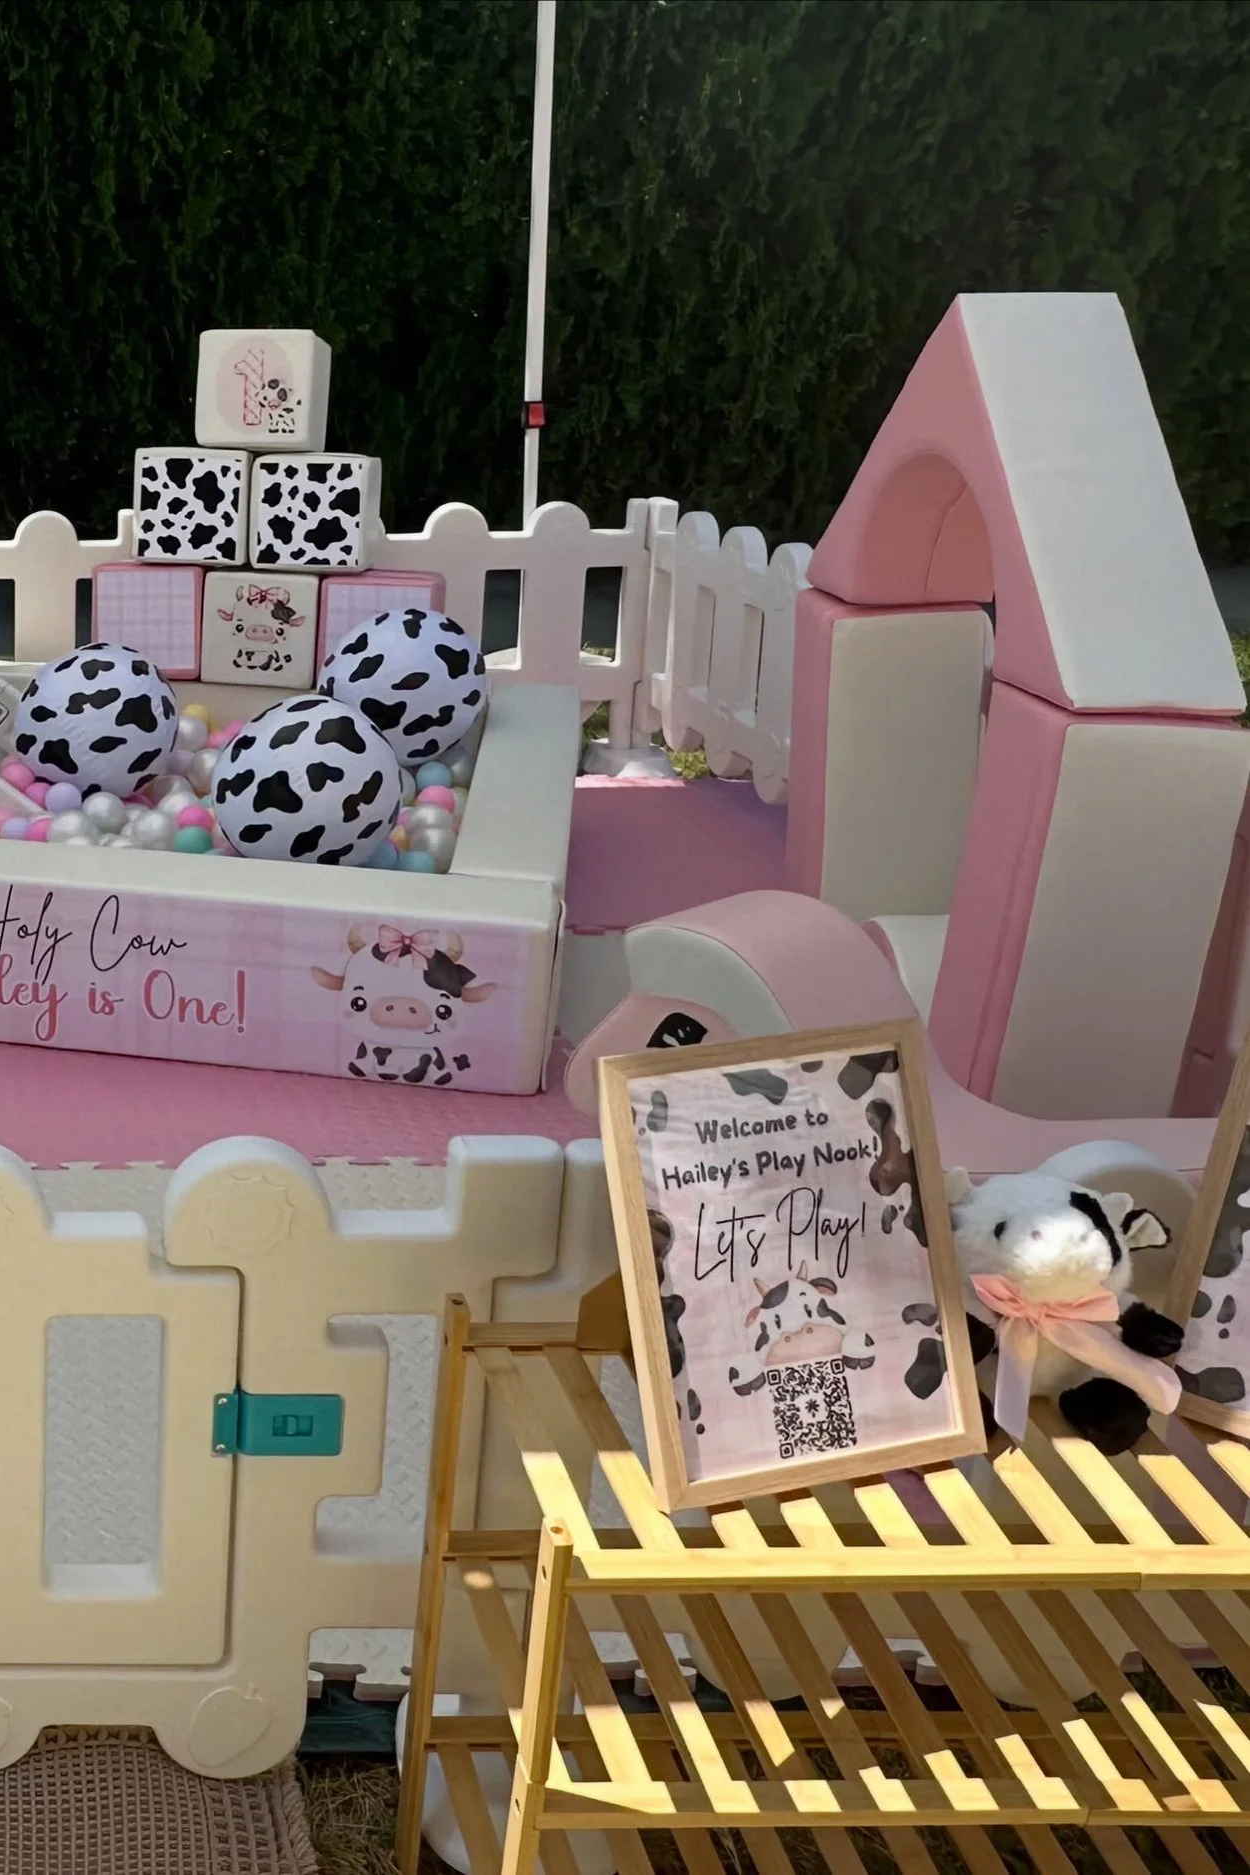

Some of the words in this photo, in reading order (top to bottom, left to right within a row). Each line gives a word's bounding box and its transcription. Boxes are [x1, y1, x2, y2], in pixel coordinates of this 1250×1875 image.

[90, 895, 188, 972] Cow
[88, 981, 124, 1016] is
[142, 968, 249, 1034] One!
[695, 1114, 797, 1144] Welcome
[805, 1108, 829, 1128] to
[661, 1158, 750, 1190] Hailey's
[755, 1149, 806, 1178] Play
[813, 1136, 880, 1165] Nook!
[694, 1202, 767, 1282] Let's
[775, 1187, 867, 1279] Play!
